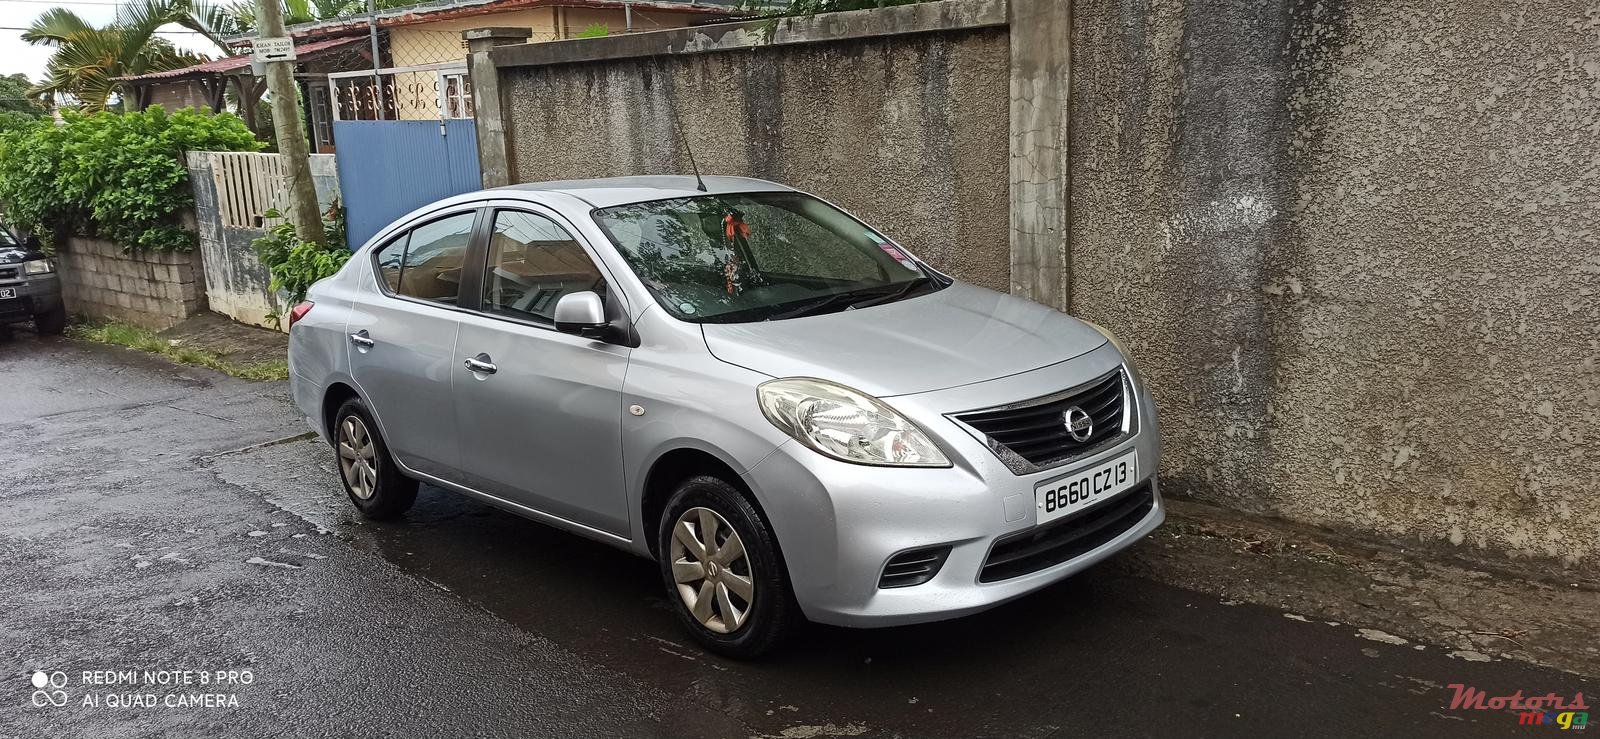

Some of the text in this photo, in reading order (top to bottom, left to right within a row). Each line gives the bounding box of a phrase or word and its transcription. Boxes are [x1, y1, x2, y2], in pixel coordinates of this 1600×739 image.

[1045, 461, 1127, 513] 8660 CZ 13
